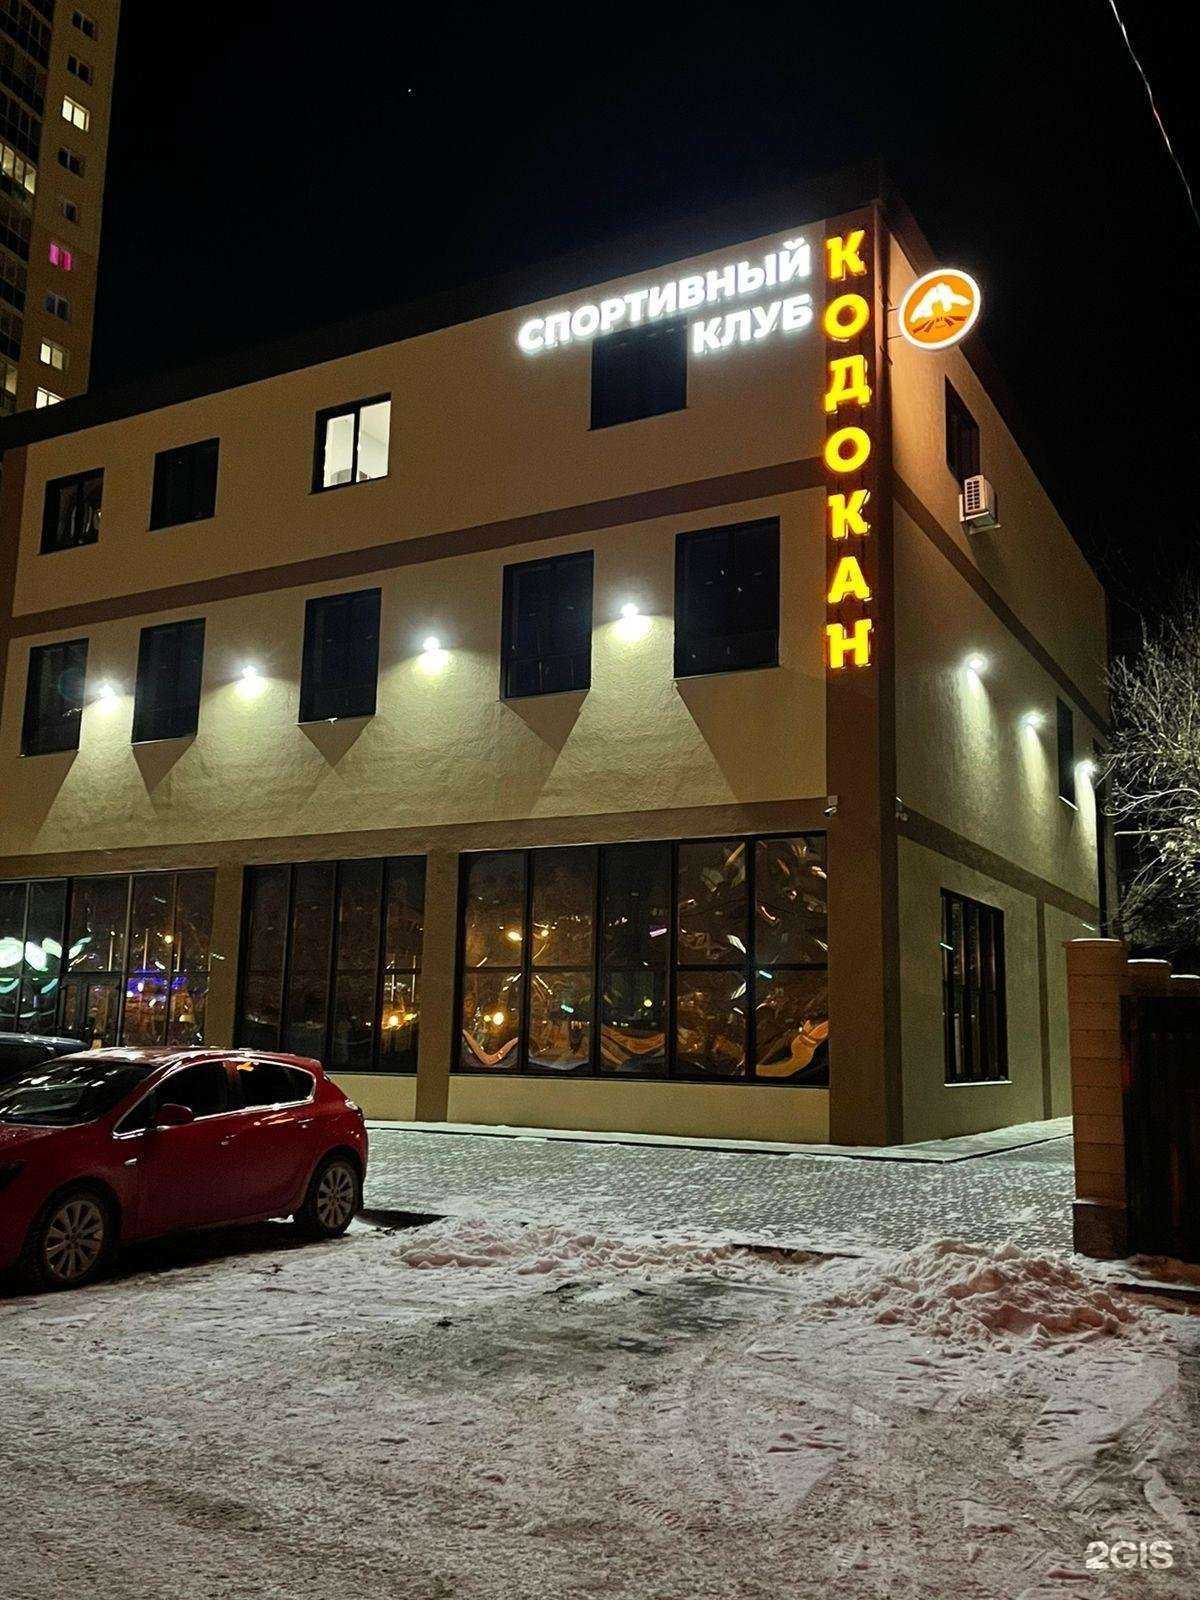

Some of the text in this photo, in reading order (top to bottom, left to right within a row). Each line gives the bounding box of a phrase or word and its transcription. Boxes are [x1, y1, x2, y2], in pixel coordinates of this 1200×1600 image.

[518, 237, 811, 352] СПОРТИВНЫЙ
[691, 293, 813, 354] КЛУБ
[825, 229, 872, 671] КОДОКАН
